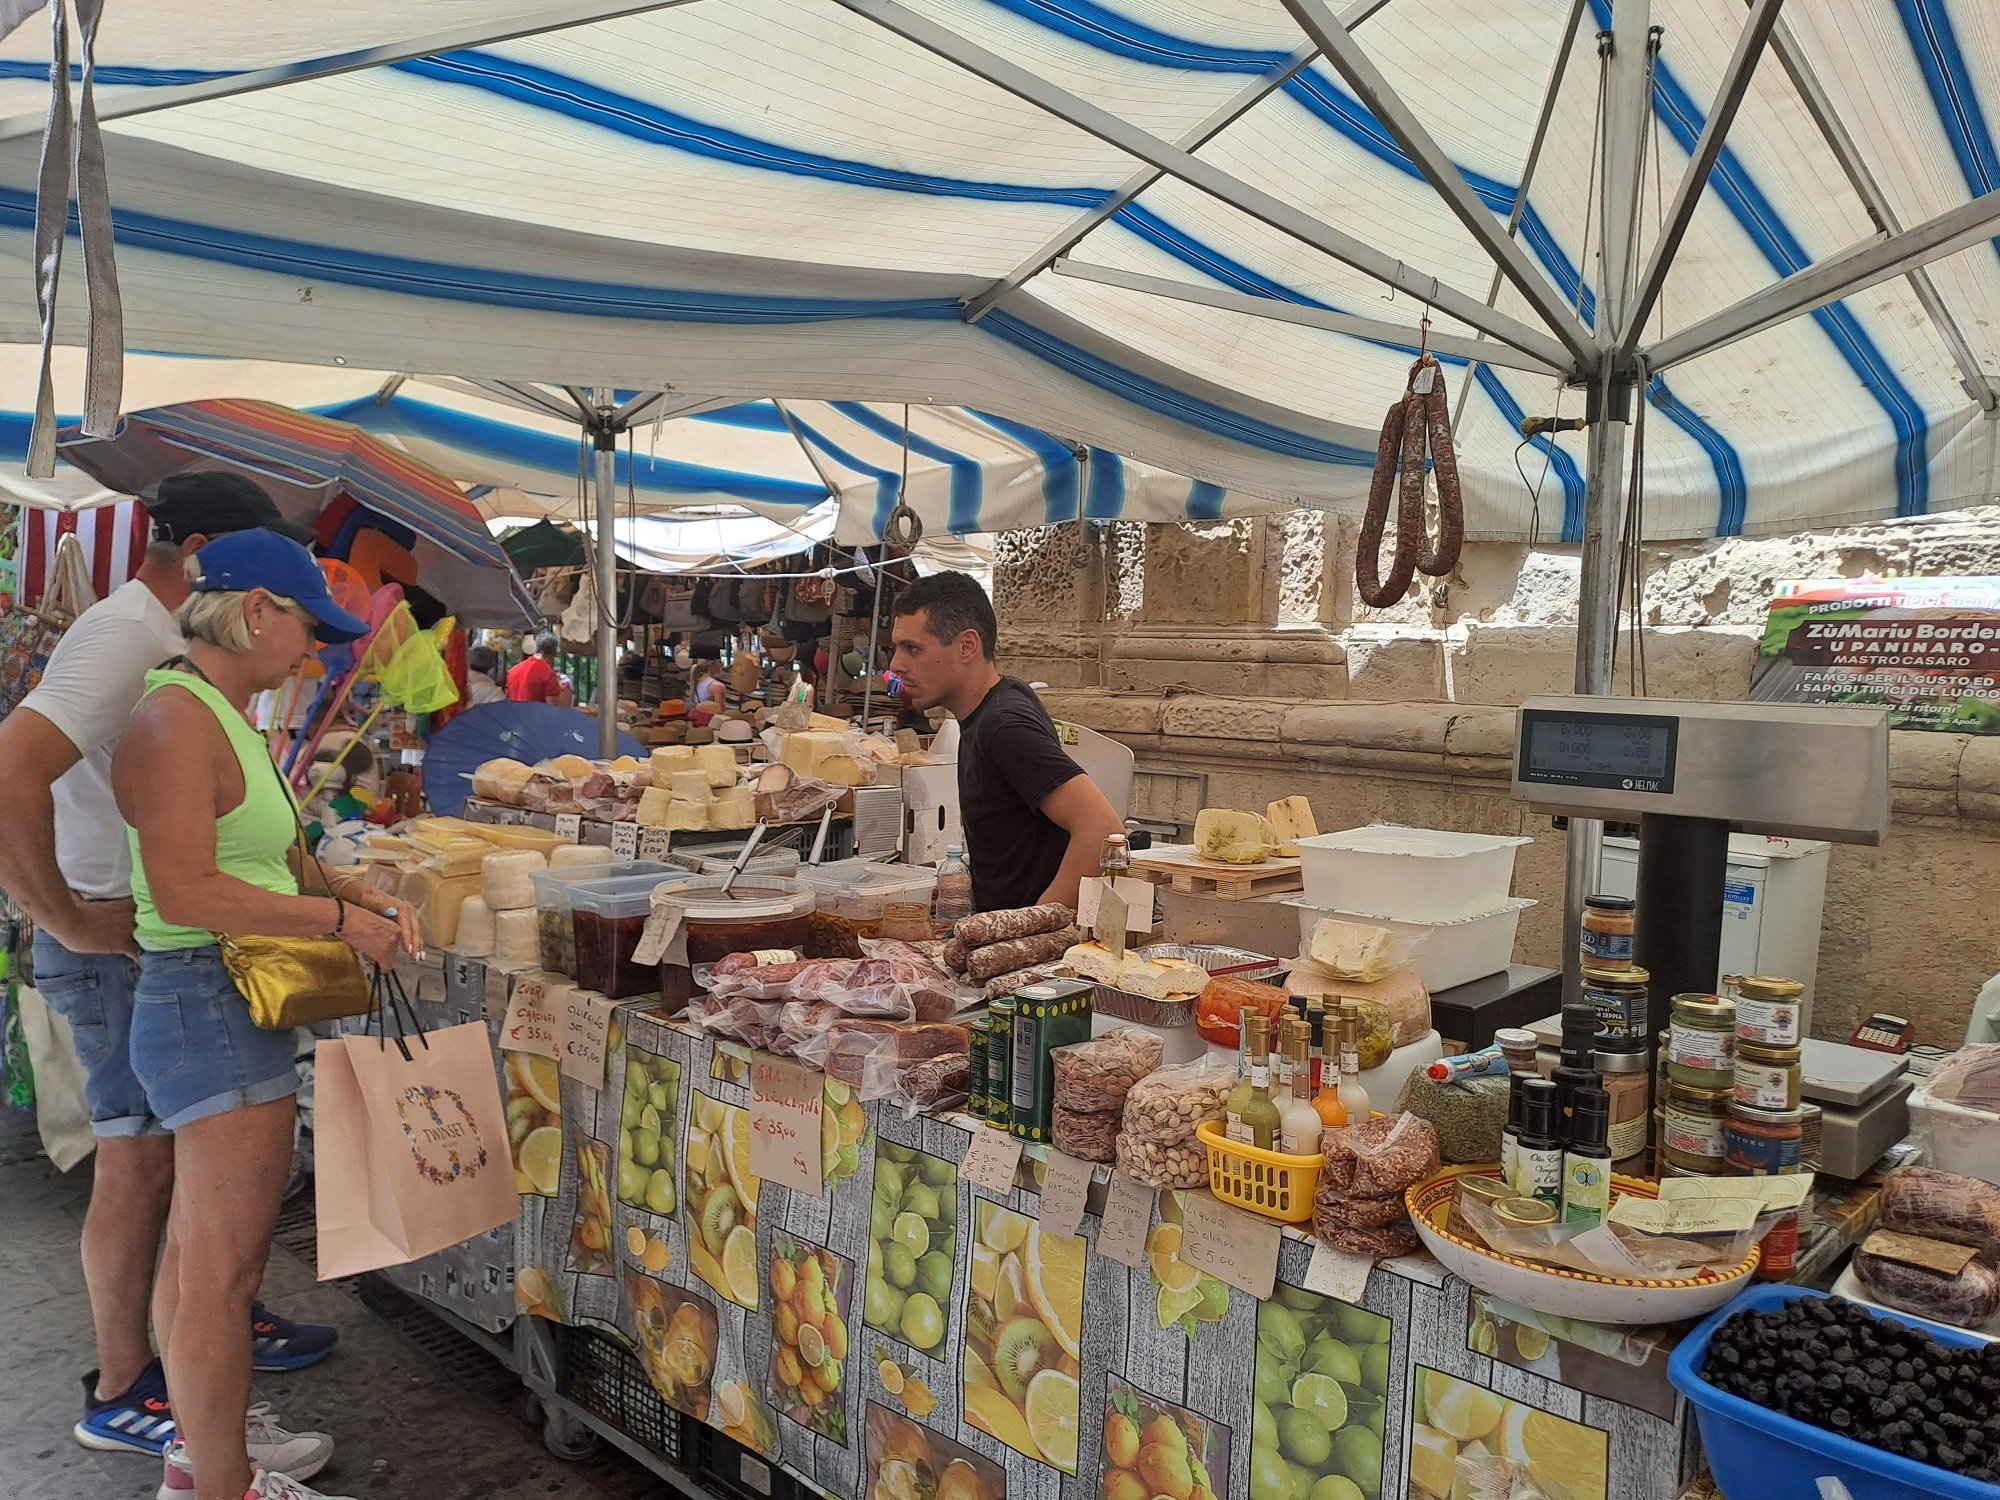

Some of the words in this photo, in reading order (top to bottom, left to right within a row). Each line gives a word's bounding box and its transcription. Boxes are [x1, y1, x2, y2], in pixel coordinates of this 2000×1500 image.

[1808, 596, 1891, 615] PRODOTTI
[1807, 624, 1913, 639] ZùMariu
[1829, 641, 1845, 652] U
[1850, 641, 1985, 654] PANINARO
[1804, 672, 1862, 683] FAMOSI
[1864, 673, 1893, 684] PER
[1897, 674, 1911, 683] IL
[1914, 675, 1970, 686] GUSTO
[1973, 677, 1995, 686] ED
[1802, 683, 1858, 693] SAPORI
[1860, 685, 1905, 695] TIPICI
[1908, 686, 1939, 697] DEL
[1941, 687, 2000, 700] LUOGO
[1898, 703, 1911, 712] ci
[1911, 715, 1941, 724] Tempio
[1953, 717, 1981, 726] Apollo
[517, 983, 545, 999] CUORI
[516, 1008, 556, 1025] CARCIOFI
[1602, 1012, 1623, 1020] SEPPIA
[510, 1025, 525, 1040] €
[527, 1026, 553, 1042] 35,00
[567, 1041, 576, 1055] €
[576, 1043, 600, 1063] 25,00
[421, 1121, 466, 1144] TWINSET
[752, 1118, 763, 1132] €
[767, 1119, 797, 1141] 35,00
[1529, 1153, 1545, 1162] Olio
[1189, 1242, 1203, 1261] €
